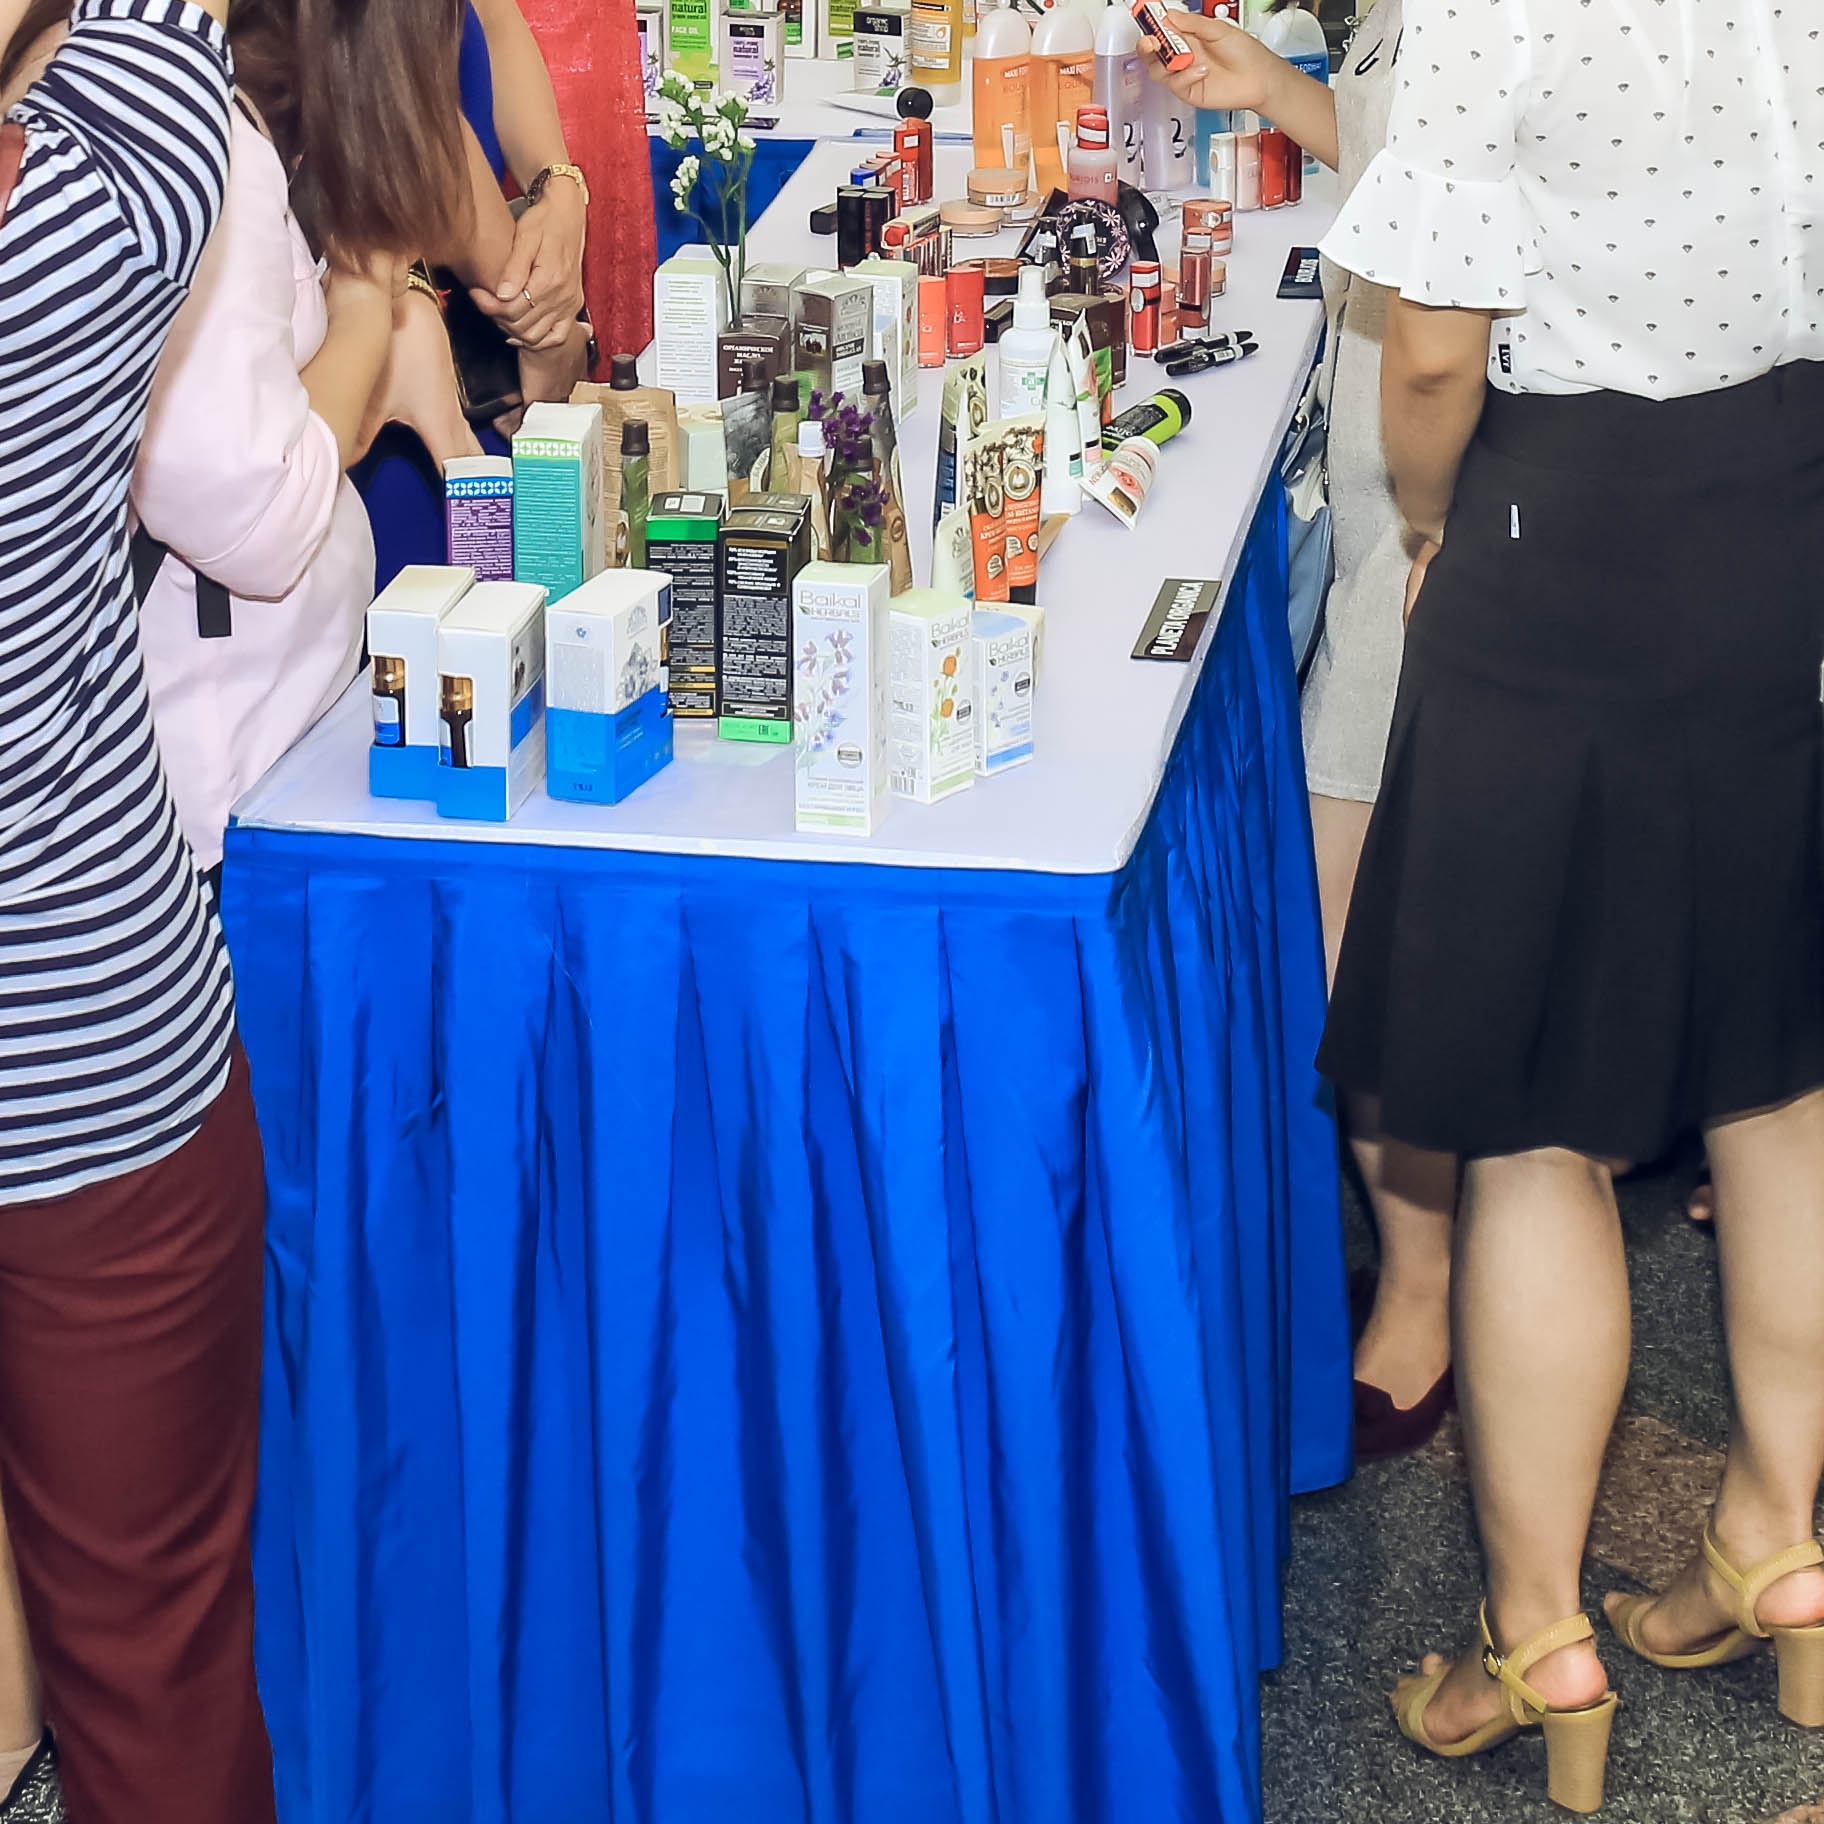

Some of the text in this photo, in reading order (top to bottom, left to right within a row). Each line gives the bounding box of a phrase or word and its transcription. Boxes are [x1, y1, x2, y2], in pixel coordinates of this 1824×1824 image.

[672, 2, 707, 14] natural
[800, 590, 861, 609] Baikal
[1150, 582, 1204, 655] PLANETA ORGANICA
